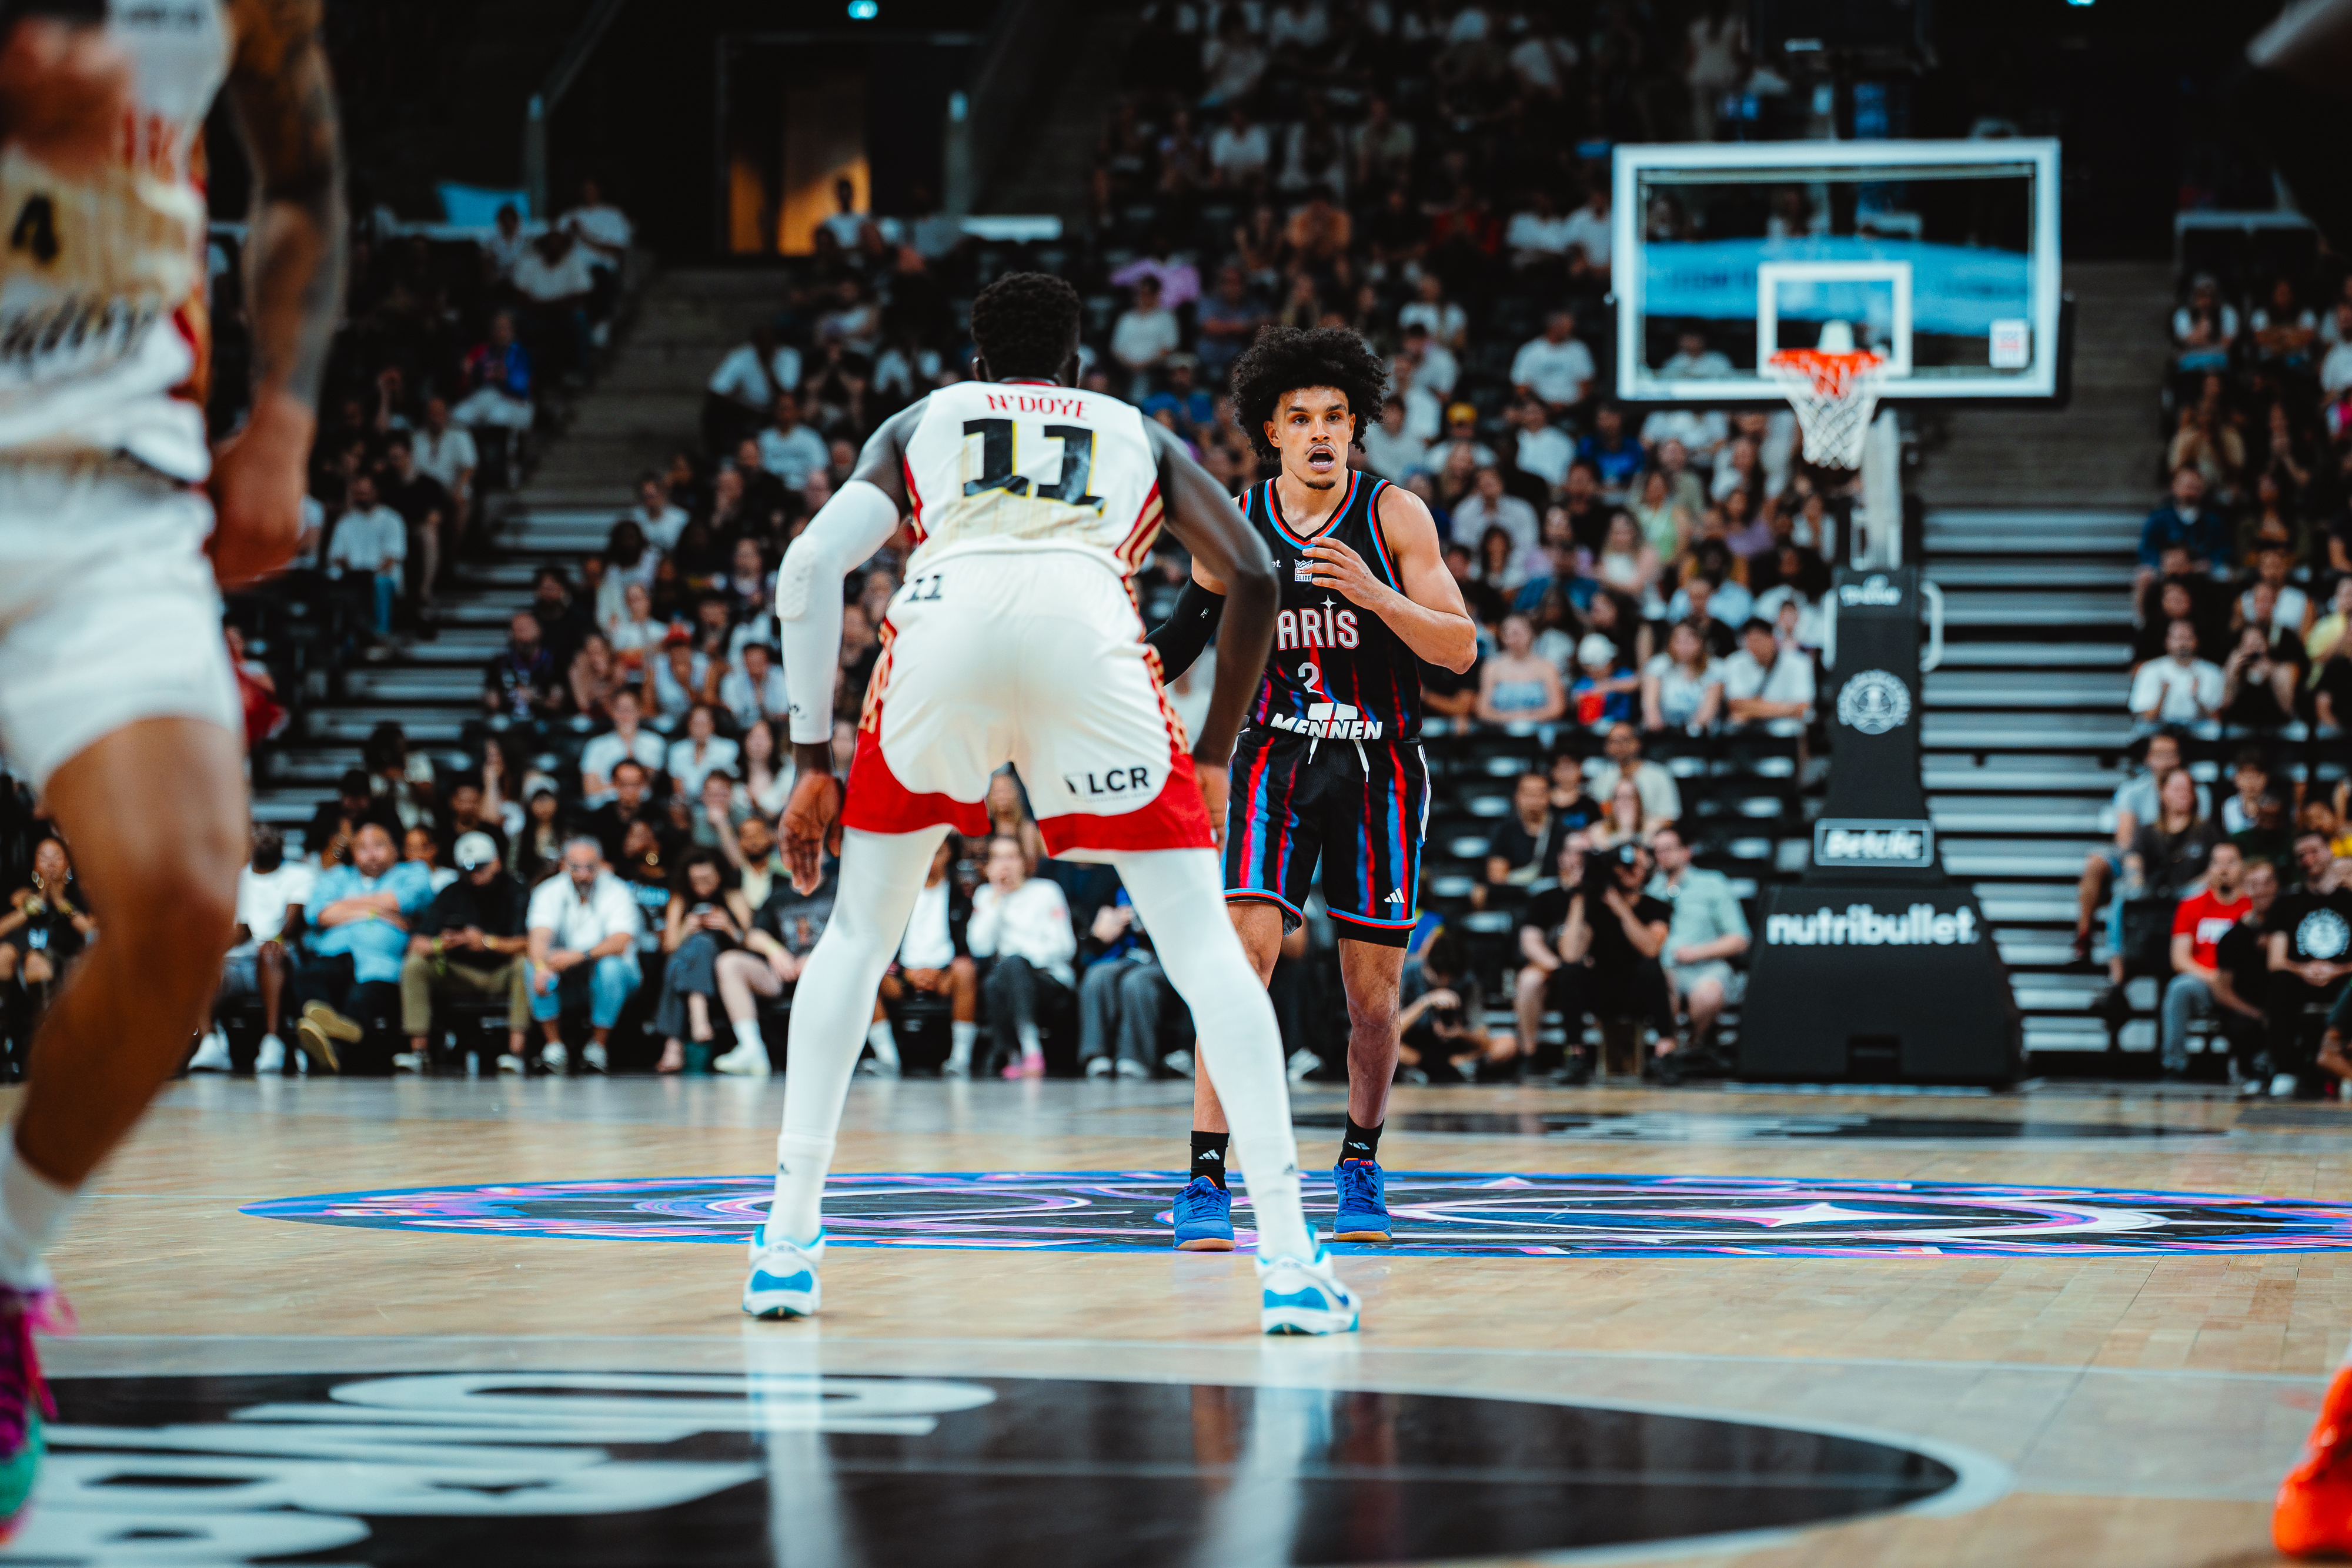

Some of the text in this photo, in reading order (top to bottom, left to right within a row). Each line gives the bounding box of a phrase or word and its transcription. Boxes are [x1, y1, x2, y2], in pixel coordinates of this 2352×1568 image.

[985, 393, 1093, 422] N'DOYE
[963, 418, 1107, 519] 11
[904, 575, 942, 603] 11
[1277, 608, 1359, 651] ARIS
[1298, 662, 1325, 695] 2
[1270, 713, 1383, 740] MENNEN
[1088, 767, 1150, 794] LCR
